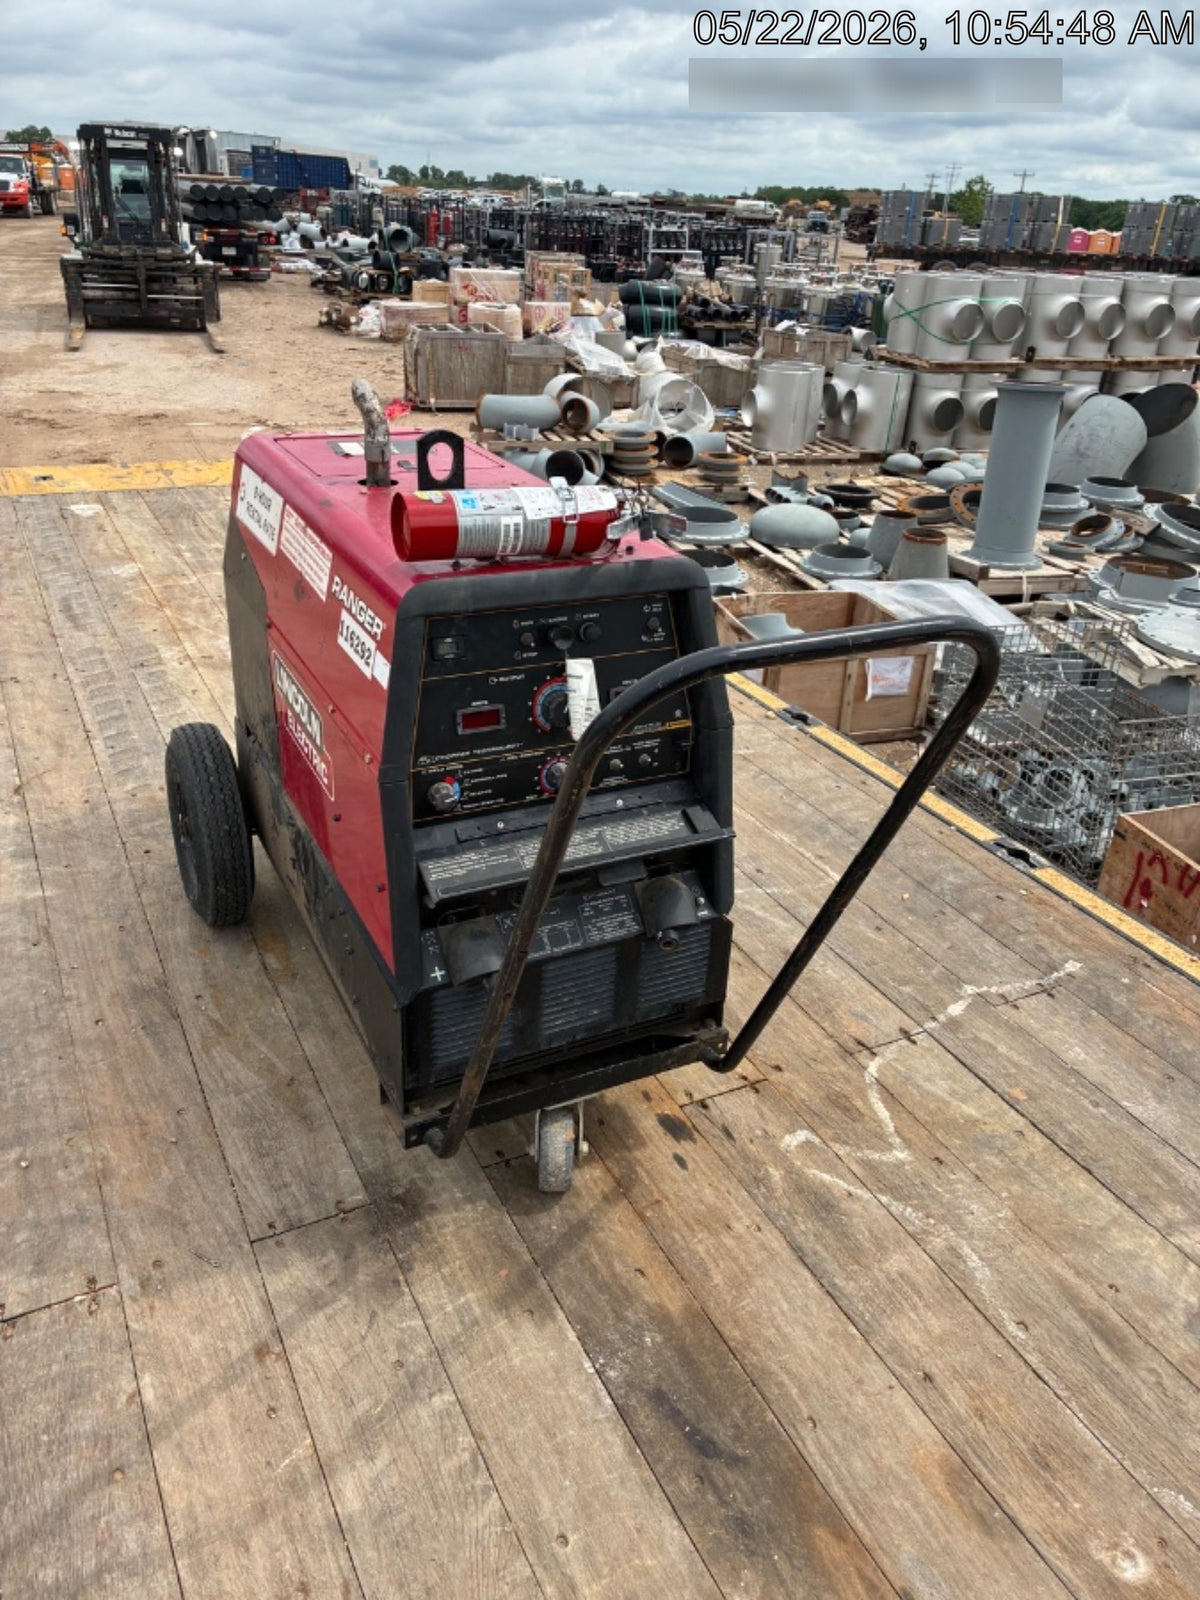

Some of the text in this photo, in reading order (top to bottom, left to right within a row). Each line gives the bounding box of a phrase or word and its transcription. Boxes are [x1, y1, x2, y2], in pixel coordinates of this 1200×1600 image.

[331, 575, 384, 641] RANGER
[274, 658, 322, 747] LINCOLN
[286, 708, 329, 785] ELECTRIC
